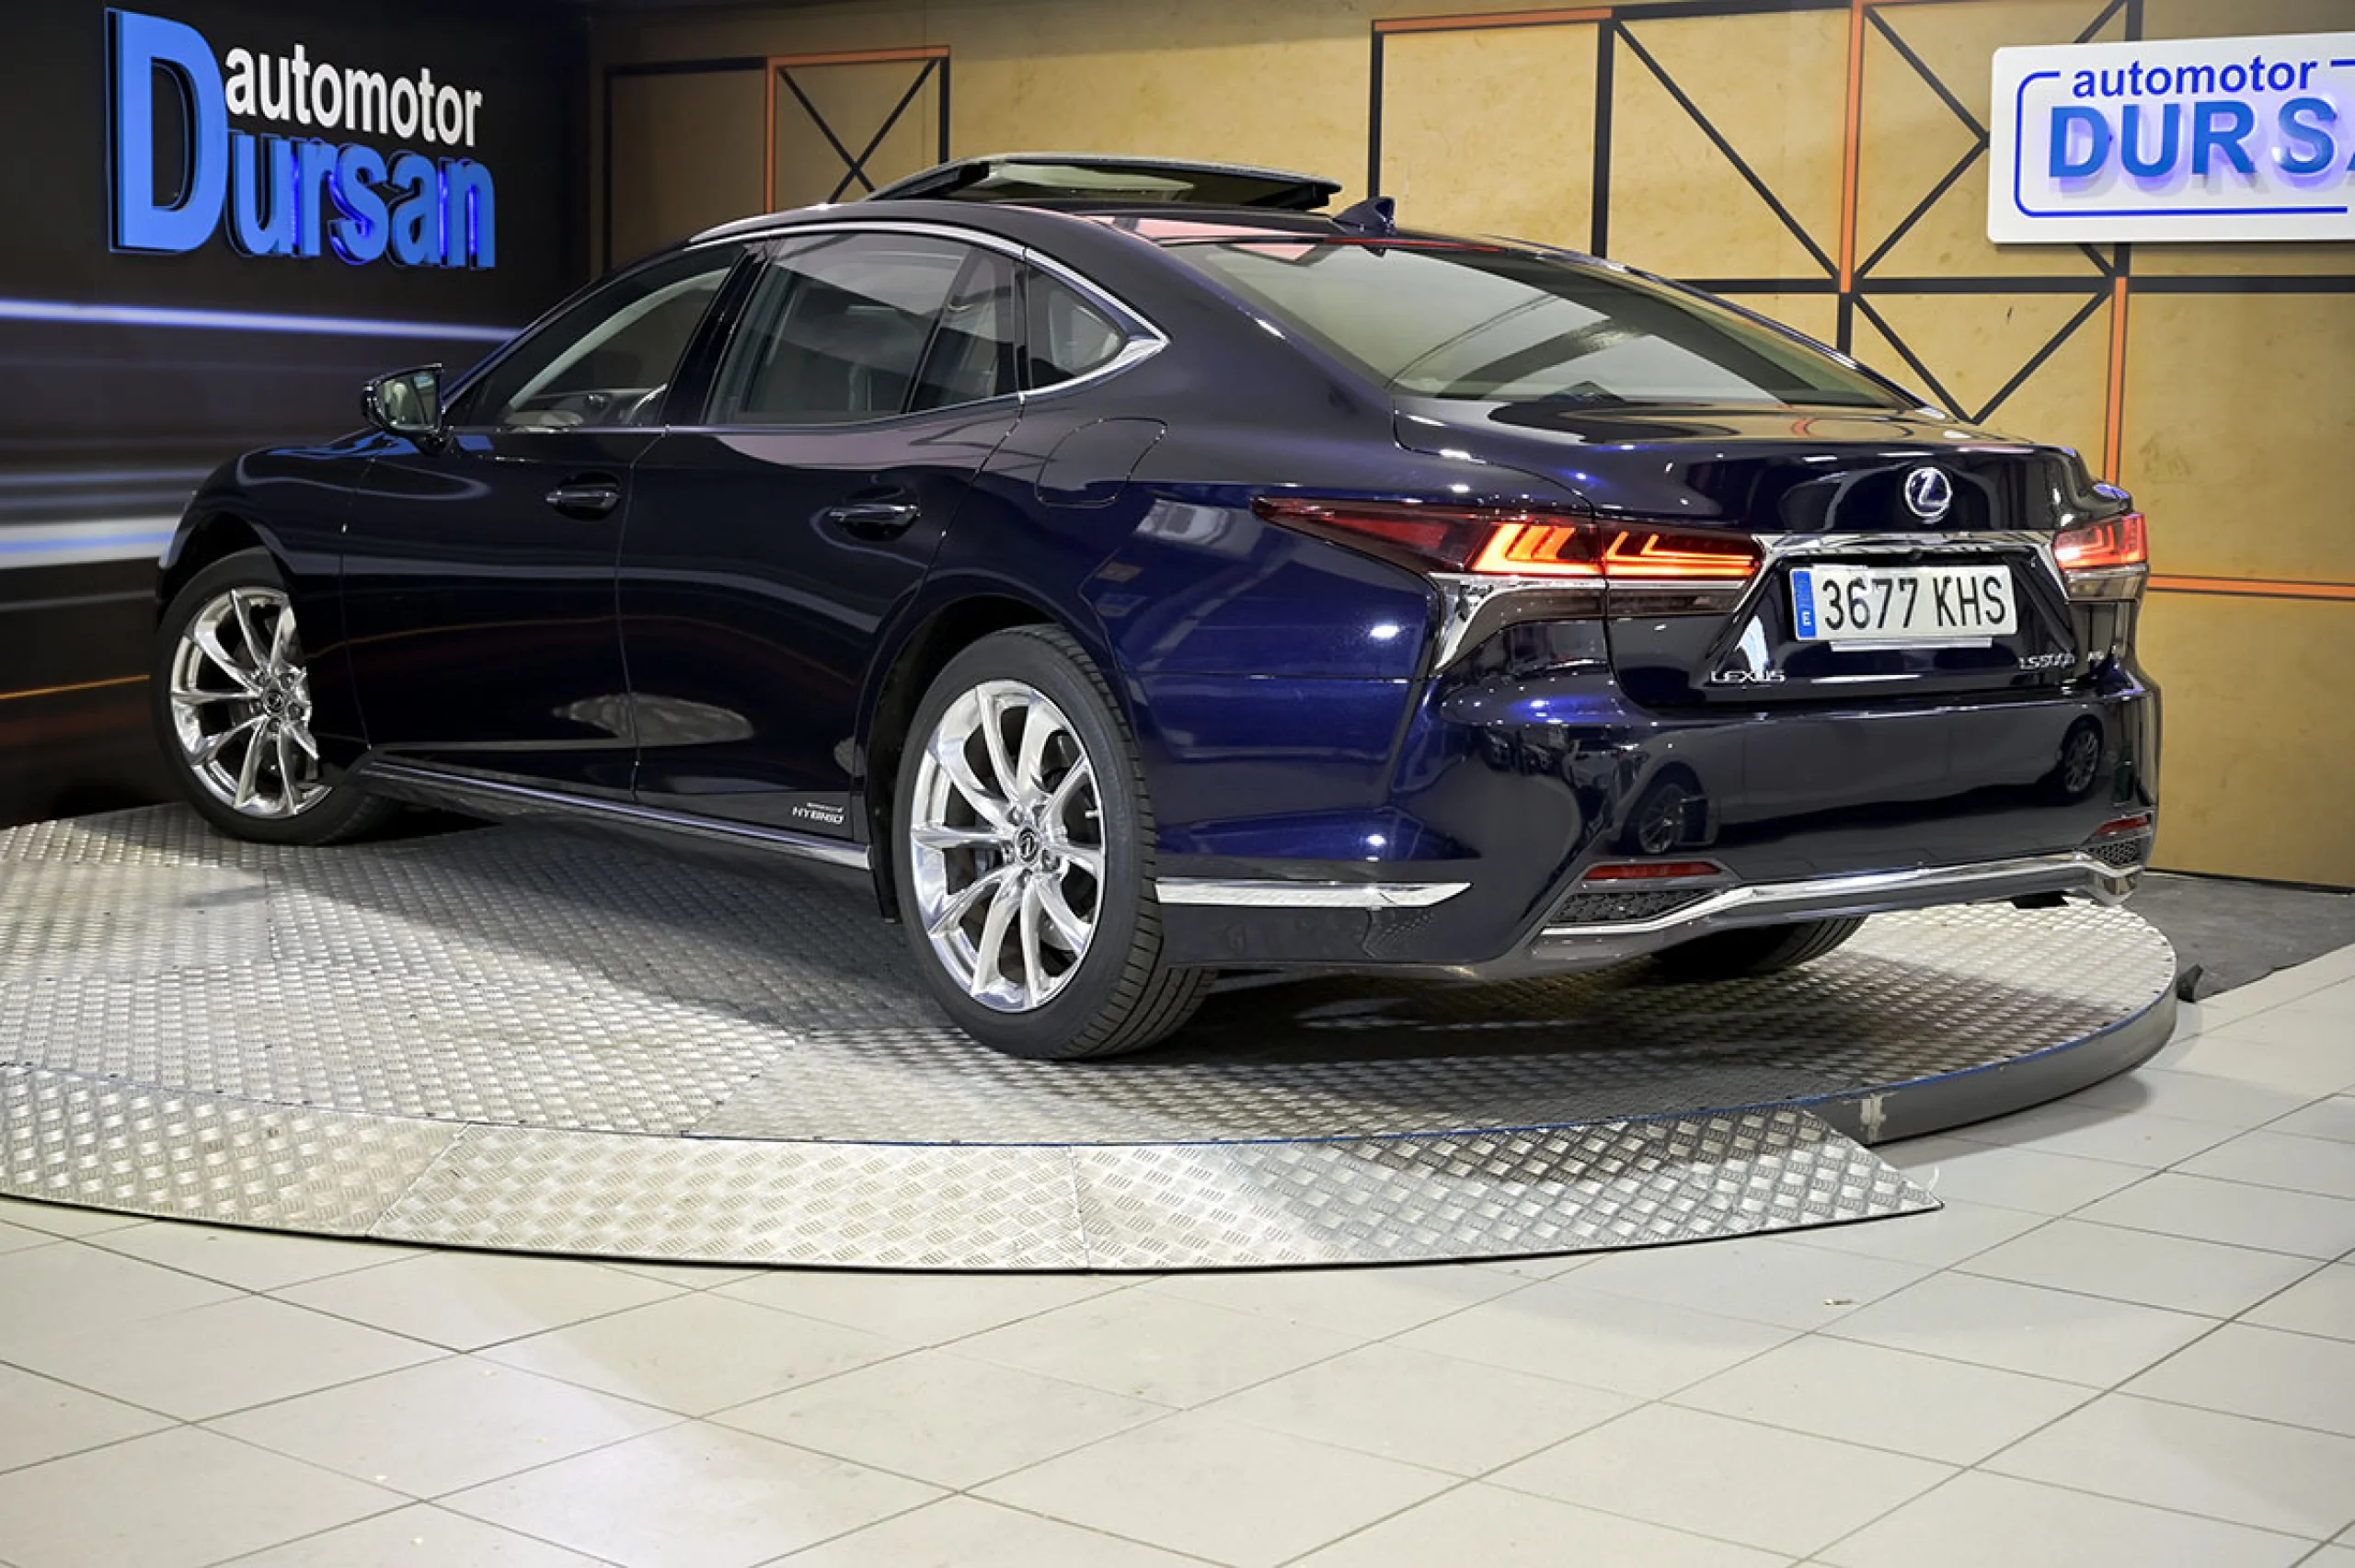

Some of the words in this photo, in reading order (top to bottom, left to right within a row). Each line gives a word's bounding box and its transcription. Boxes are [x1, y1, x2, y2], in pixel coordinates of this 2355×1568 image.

[225, 43, 483, 147] automotor
[2073, 55, 2318, 98] automotor
[104, 7, 496, 269] Dursan
[2049, 97, 2355, 177] DURS
[1801, 612, 1812, 627] E
[1822, 577, 1919, 631] 3677
[1932, 575, 2006, 627] KHS
[1710, 670, 1786, 684] LEXUS
